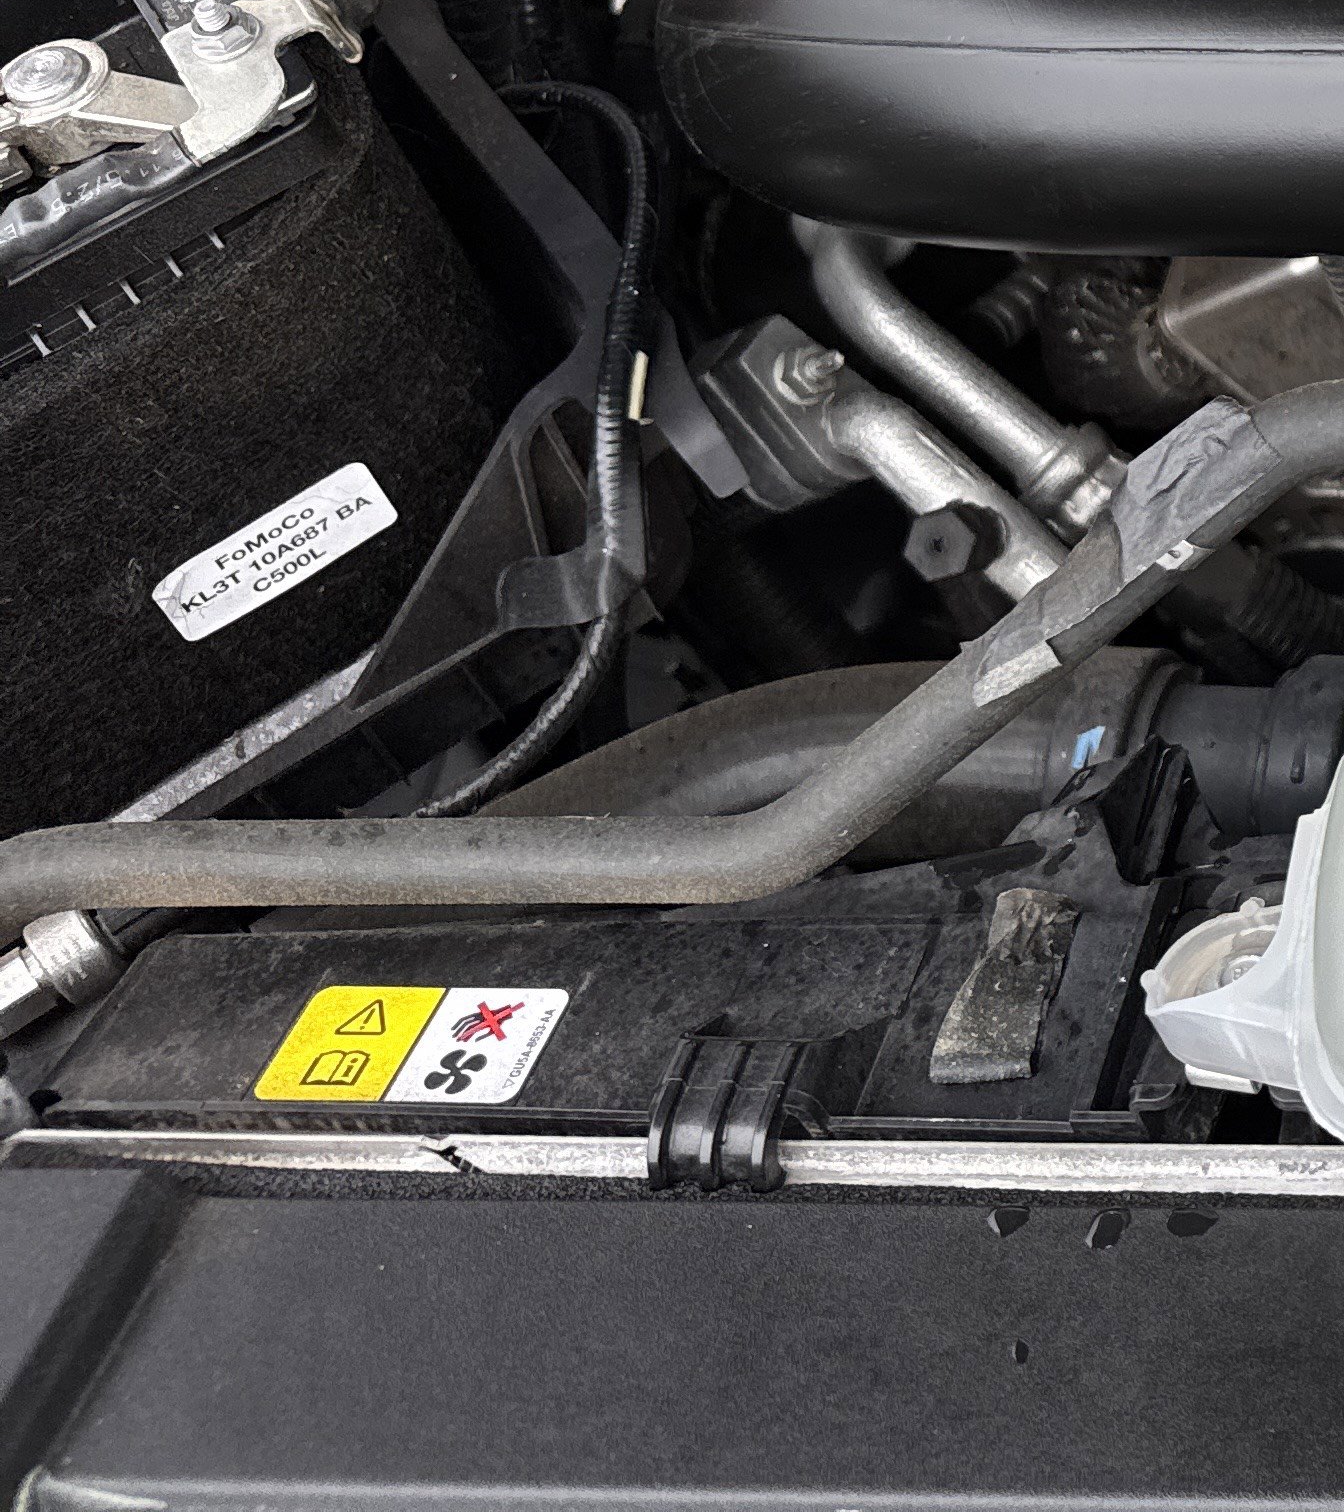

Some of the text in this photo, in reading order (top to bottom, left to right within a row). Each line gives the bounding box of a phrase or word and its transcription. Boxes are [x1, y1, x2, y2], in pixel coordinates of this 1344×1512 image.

[181, 496, 373, 613] KL3T 10A687 BA
[214, 507, 315, 571] FoMoCo
[253, 546, 327, 592] C500L
